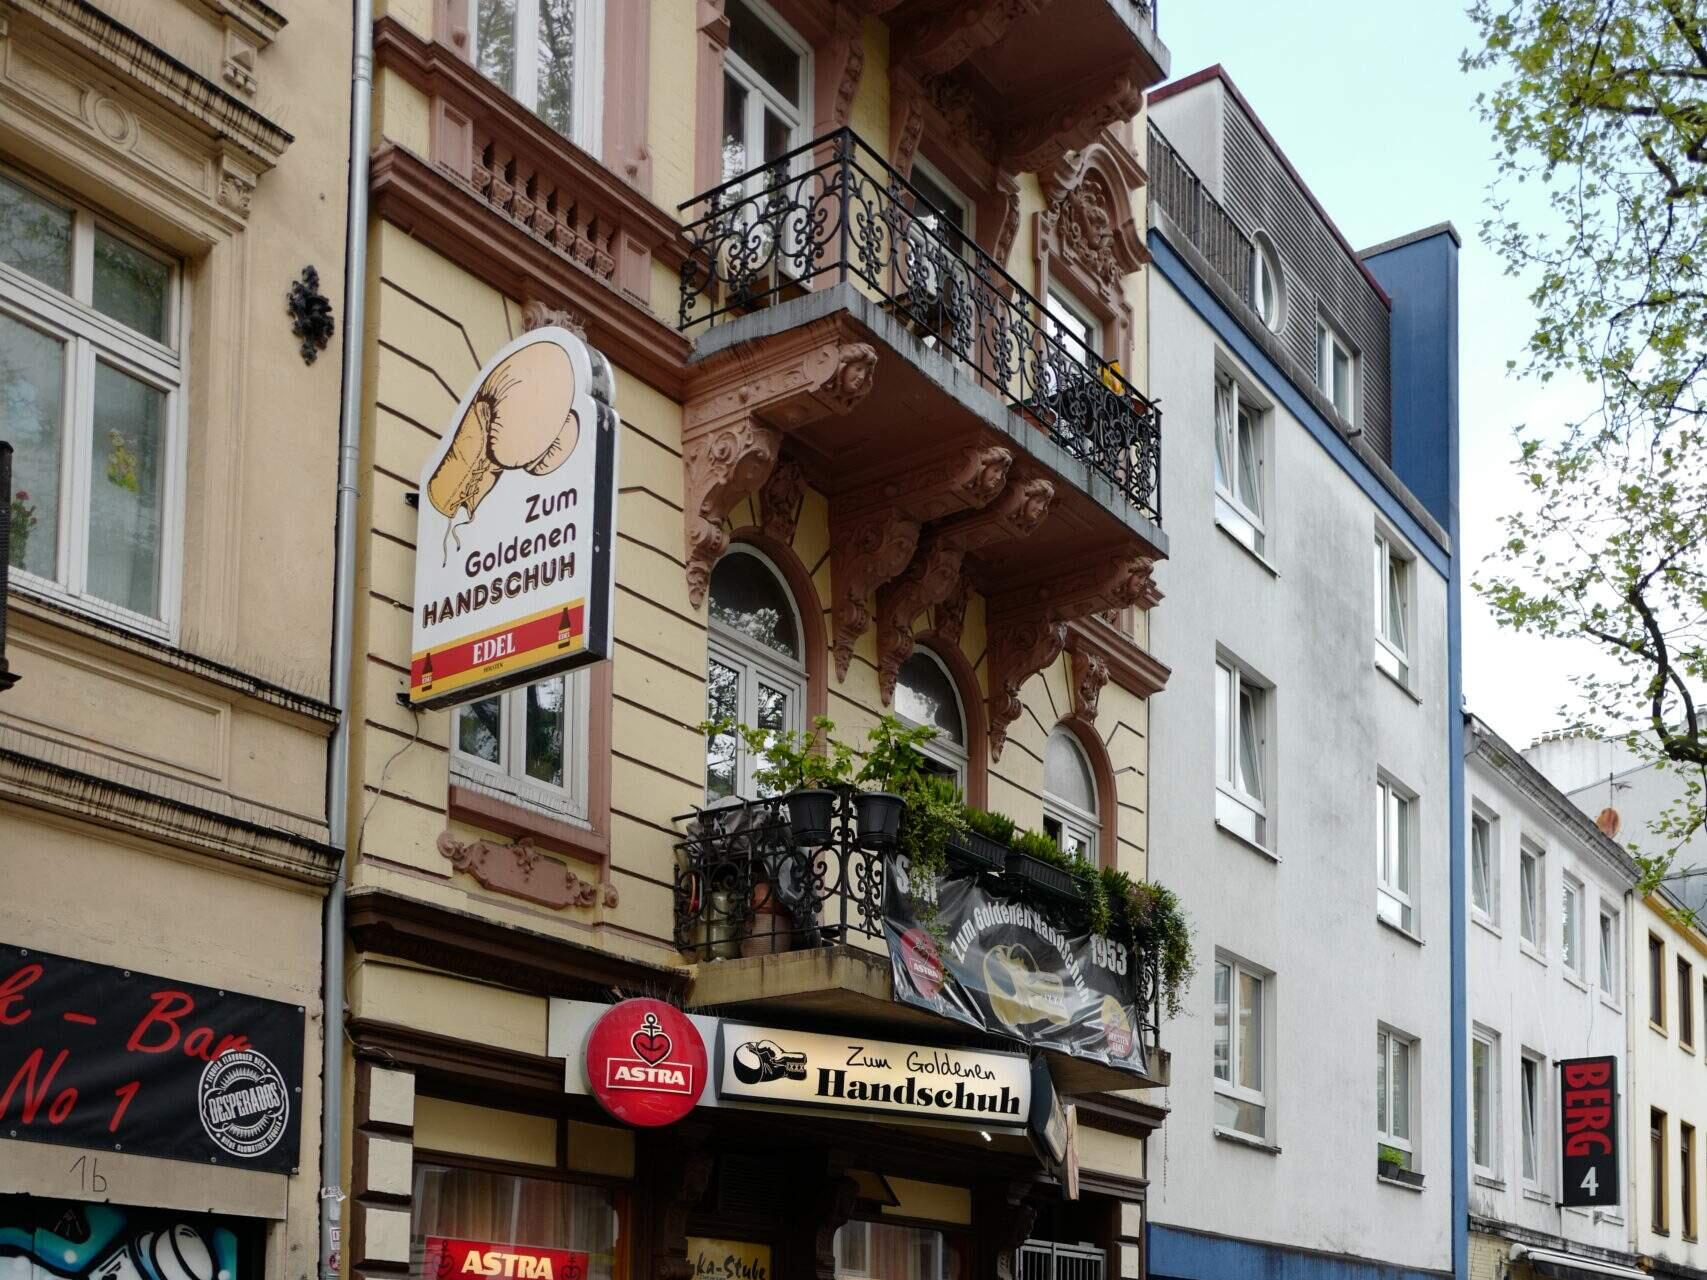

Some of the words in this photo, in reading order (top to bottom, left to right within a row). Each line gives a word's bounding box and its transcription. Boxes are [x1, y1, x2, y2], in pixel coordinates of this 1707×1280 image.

[524, 486, 578, 524] Zum
[464, 521, 577, 578] Goldenen
[422, 551, 576, 630] HANDSCHUH
[472, 631, 516, 665] EDEL
[950, 917, 978, 966] Zum
[973, 901, 1033, 931] Goldenen
[1090, 933, 1129, 977] 1953
[912, 962, 939, 980] ASTRA
[126, 990, 253, 1062] Bar
[614, 1065, 686, 1087] ASTRA
[845, 1046, 893, 1070] Zum
[907, 1048, 997, 1081] Goldenen
[0, 1047, 79, 1125] No
[108, 1080, 141, 1133] 1
[207, 1082, 280, 1124] DESPERADOS
[816, 1067, 1021, 1115] Handschuh
[1564, 1063, 1612, 1158] BERG
[1579, 1165, 1600, 1197] 4
[461, 1250, 555, 1280] ASTRA
